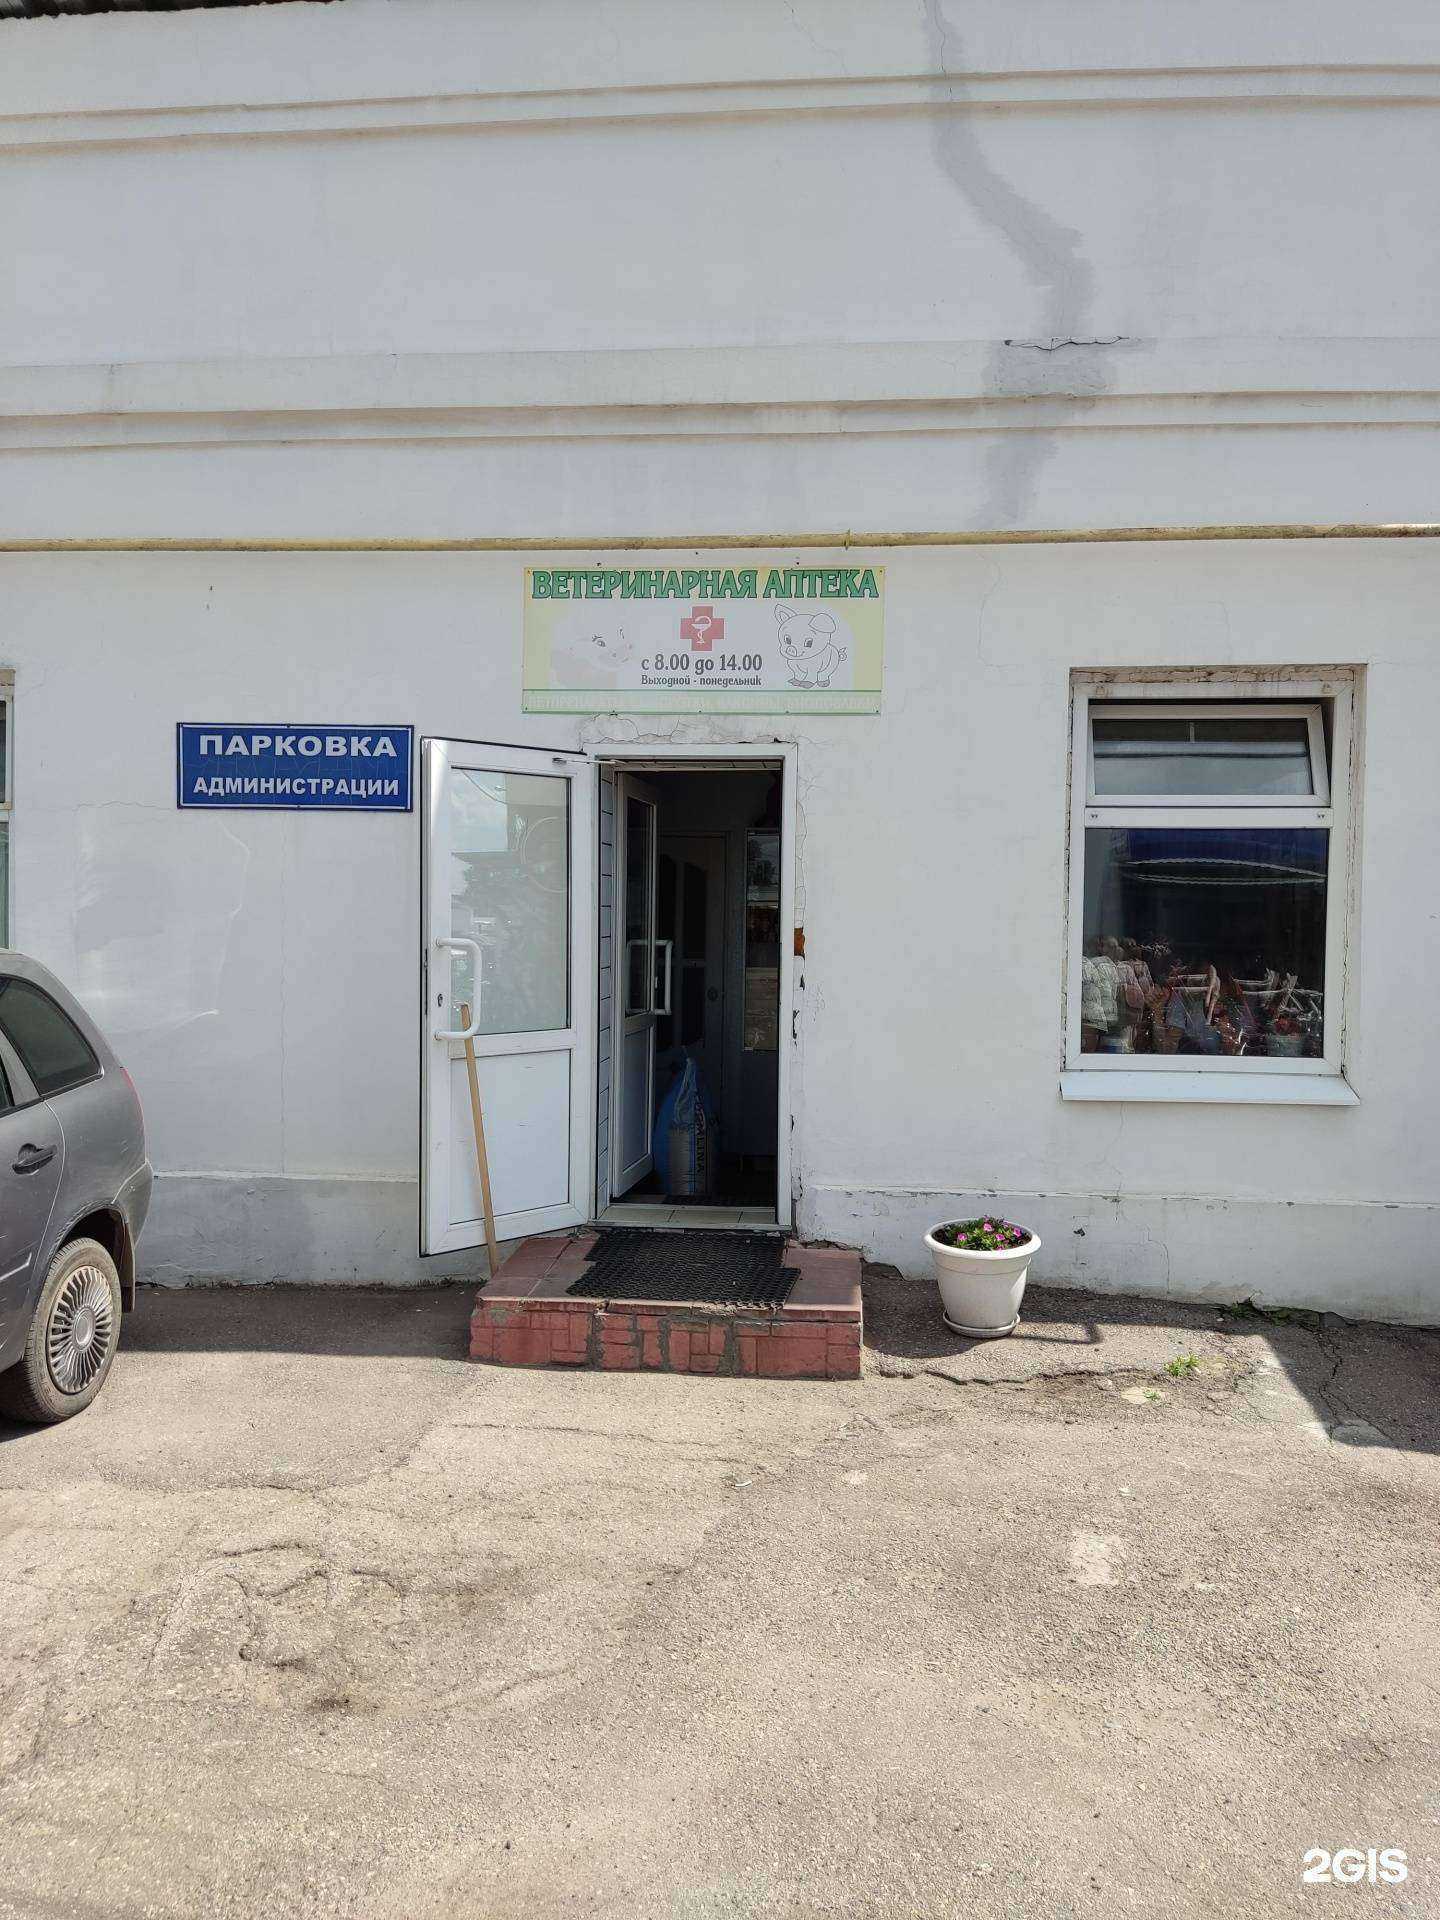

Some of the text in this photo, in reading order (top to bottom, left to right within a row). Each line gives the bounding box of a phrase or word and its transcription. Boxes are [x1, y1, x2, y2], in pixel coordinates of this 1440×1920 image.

[532, 569, 879, 599] ВЕТЕРИНАРНАЯ АПТЕКА
[641, 654, 763, 675] с 8.00 до 14.00
[641, 674, 691, 687] Выходной
[699, 675, 762, 687] понедельник
[199, 735, 398, 757] ПАРКОВКА
[193, 777, 399, 798] АДМИНИСТРАЦИИ
